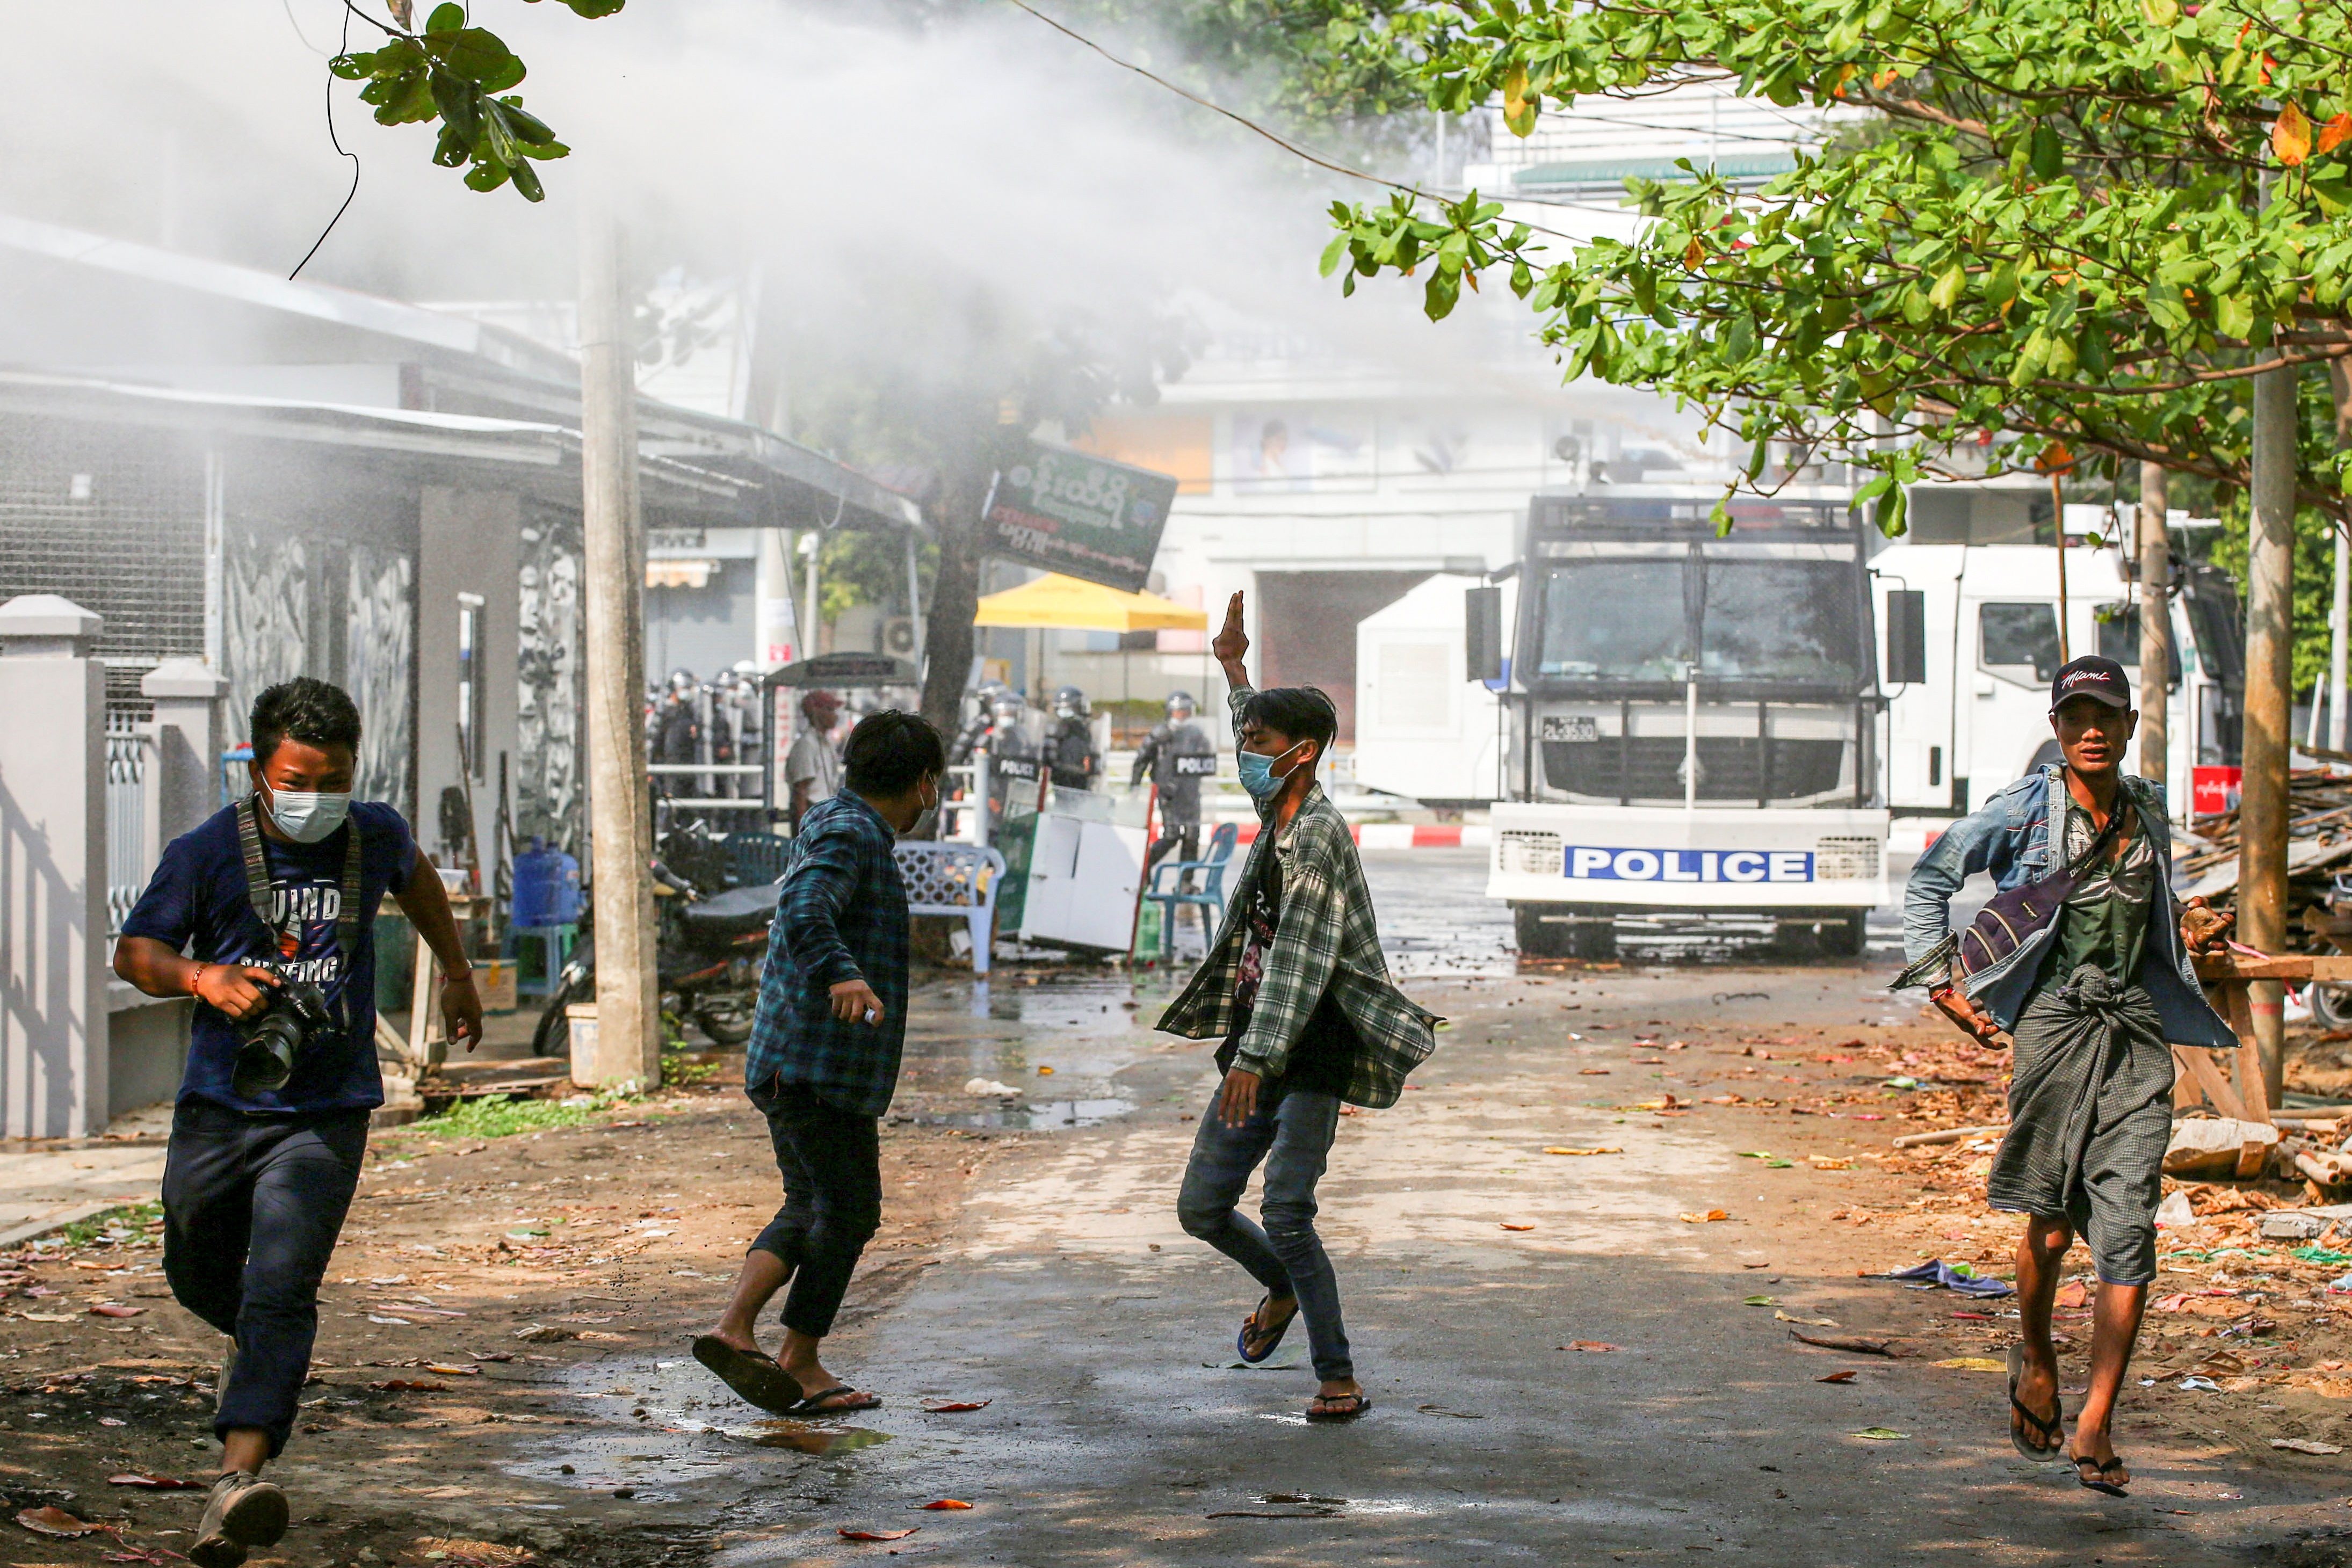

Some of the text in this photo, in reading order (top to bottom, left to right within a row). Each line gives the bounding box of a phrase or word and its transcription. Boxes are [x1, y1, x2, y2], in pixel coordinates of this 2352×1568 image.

[2060, 669, 2110, 689] Miami
[1573, 848, 1807, 882] POLICE
[296, 1003, 311, 1019] Nikon
